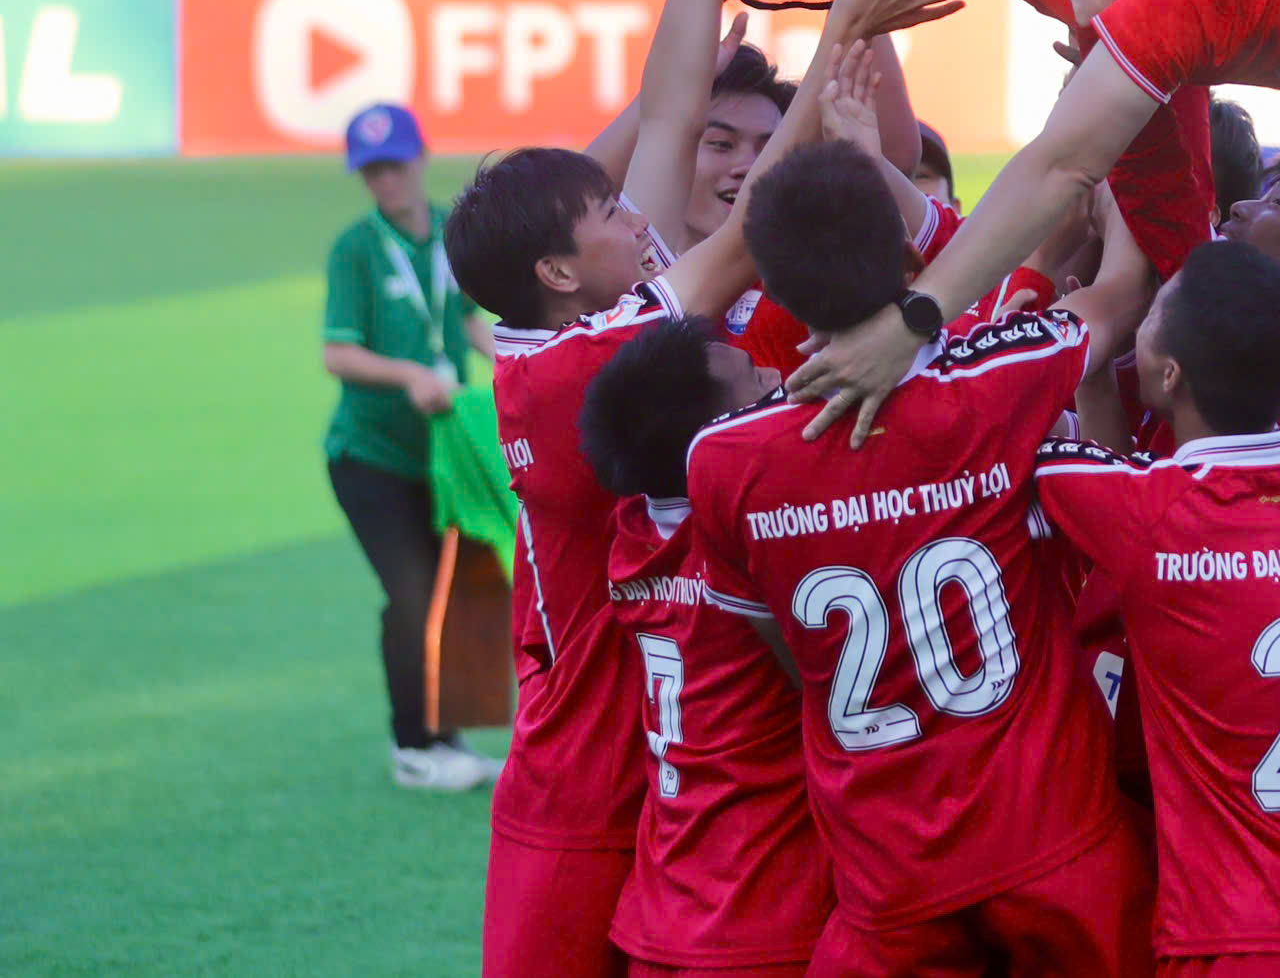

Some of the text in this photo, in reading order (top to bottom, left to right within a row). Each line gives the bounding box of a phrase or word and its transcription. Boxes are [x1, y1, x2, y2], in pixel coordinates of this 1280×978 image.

[431, 2, 649, 114] FPT
[747, 461, 1012, 541] TRƯỜNG ĐẠI HỌC THUỶ LỢI
[1155, 545, 1249, 582] TRƯỜNG
[792, 536, 1021, 751] 20
[636, 632, 684, 799] 7
